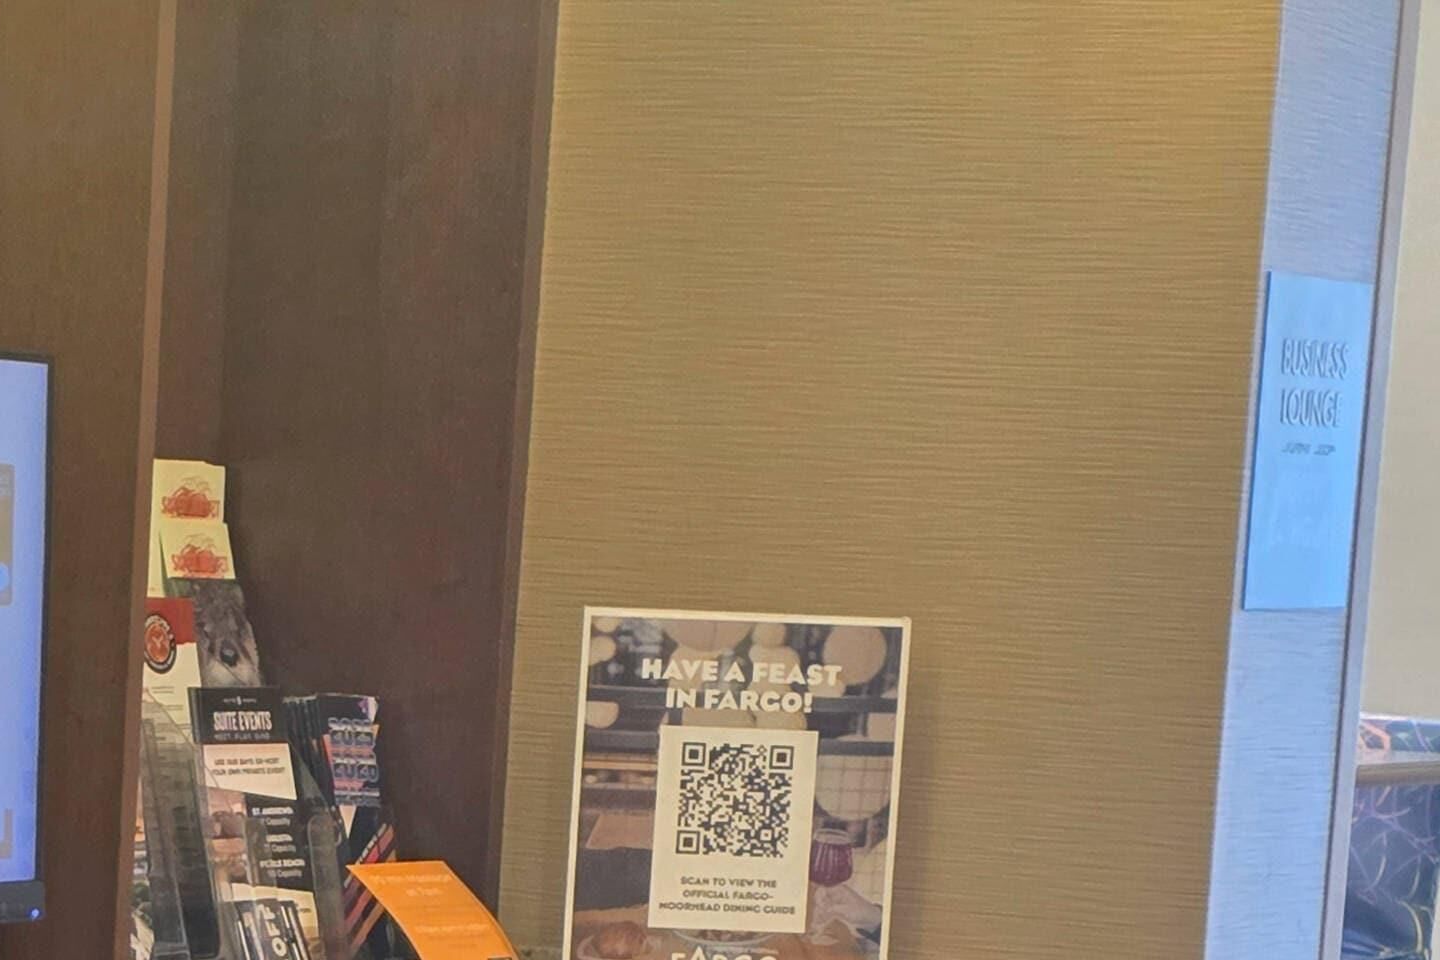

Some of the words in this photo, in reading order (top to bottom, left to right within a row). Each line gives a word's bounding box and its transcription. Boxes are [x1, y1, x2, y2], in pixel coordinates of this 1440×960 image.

[1281, 338, 1349, 380] BUSINESS
[1280, 388, 1341, 428] LOUNGE
[641, 657, 720, 681] HAVE
[724, 661, 745, 683] A
[752, 661, 842, 687] FEAST
[665, 686, 697, 709] IN
[703, 688, 814, 714] FARGO!
[213, 710, 238, 731] SUITE
[238, 710, 272, 732] EVENTS
[680, 875, 710, 886] SCAN
[712, 877, 726, 887] TO
[729, 878, 755, 888] VIEW
[756, 878, 777, 889] THE
[682, 888, 730, 900] OFFICIAL
[732, 890, 775, 901] FARGO-
[658, 902, 721, 912] MOORHEAD
[723, 903, 761, 914] DINING
[762, 904, 796, 915] GUIDE
[255, 903, 289, 957] OFF
